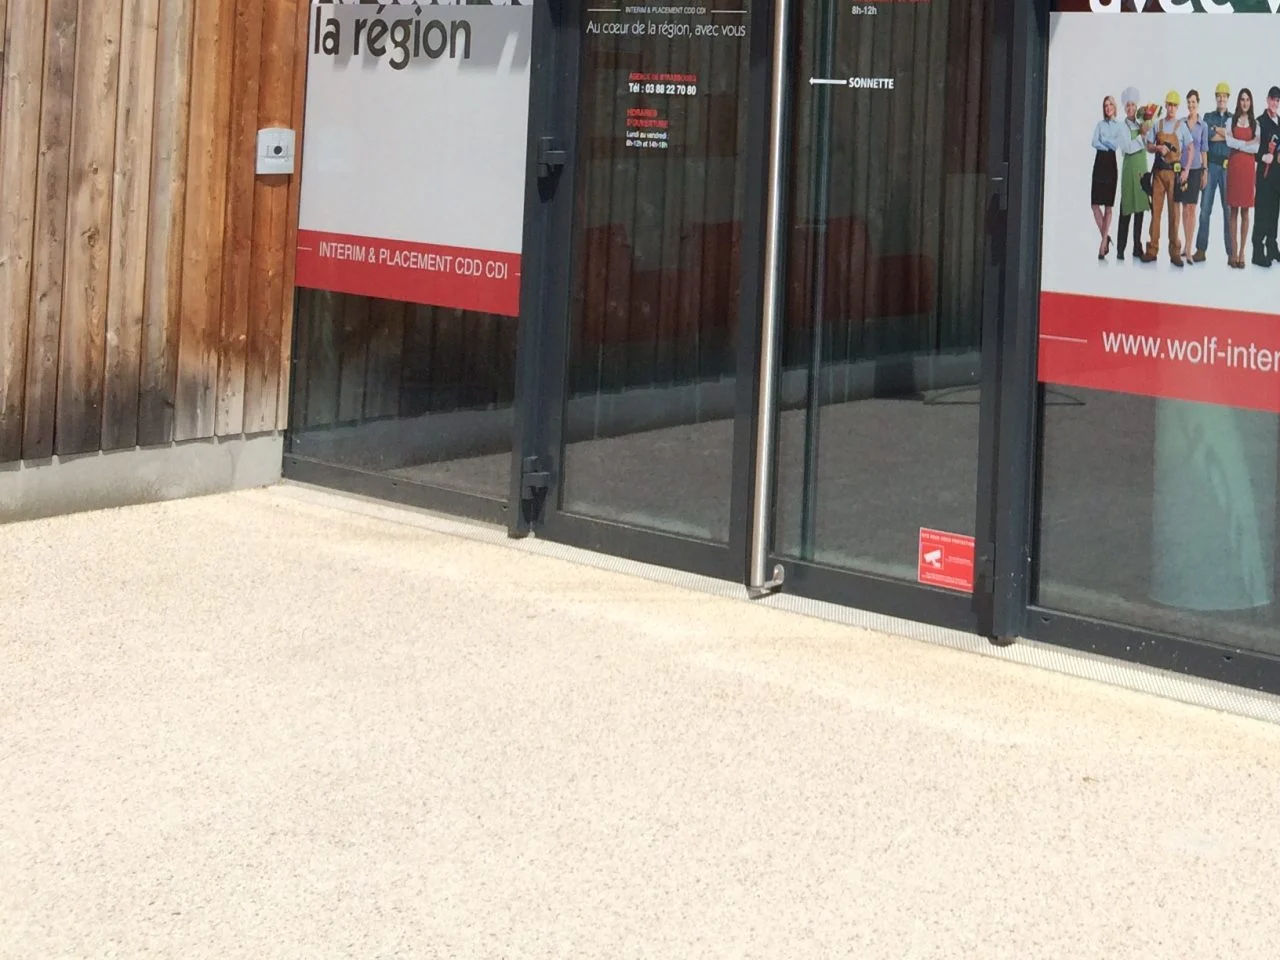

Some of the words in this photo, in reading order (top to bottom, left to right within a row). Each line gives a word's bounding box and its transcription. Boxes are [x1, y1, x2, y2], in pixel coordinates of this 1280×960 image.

[852, 6, 877, 15] 8h-12h
[314, 6, 341, 55] la
[353, 4, 472, 70] région
[586, 20, 600, 34] Au
[631, 20, 646, 35] de
[648, 20, 656, 35] la
[658, 20, 692, 39] région,
[695, 23, 719, 37] avec
[721, 24, 746, 37] vous
[628, 82, 640, 93] Tél
[645, 84, 654, 94] 03
[655, 84, 665, 94] 88
[666, 84, 676, 95] 22
[676, 85, 686, 95] 70
[849, 77, 894, 89] SONNETTE
[319, 241, 365, 262] INTERIM
[368, 249, 376, 263] &
[379, 248, 452, 272] PLACEMENT
[455, 257, 482, 276] CDD
[485, 260, 508, 279] CDI
